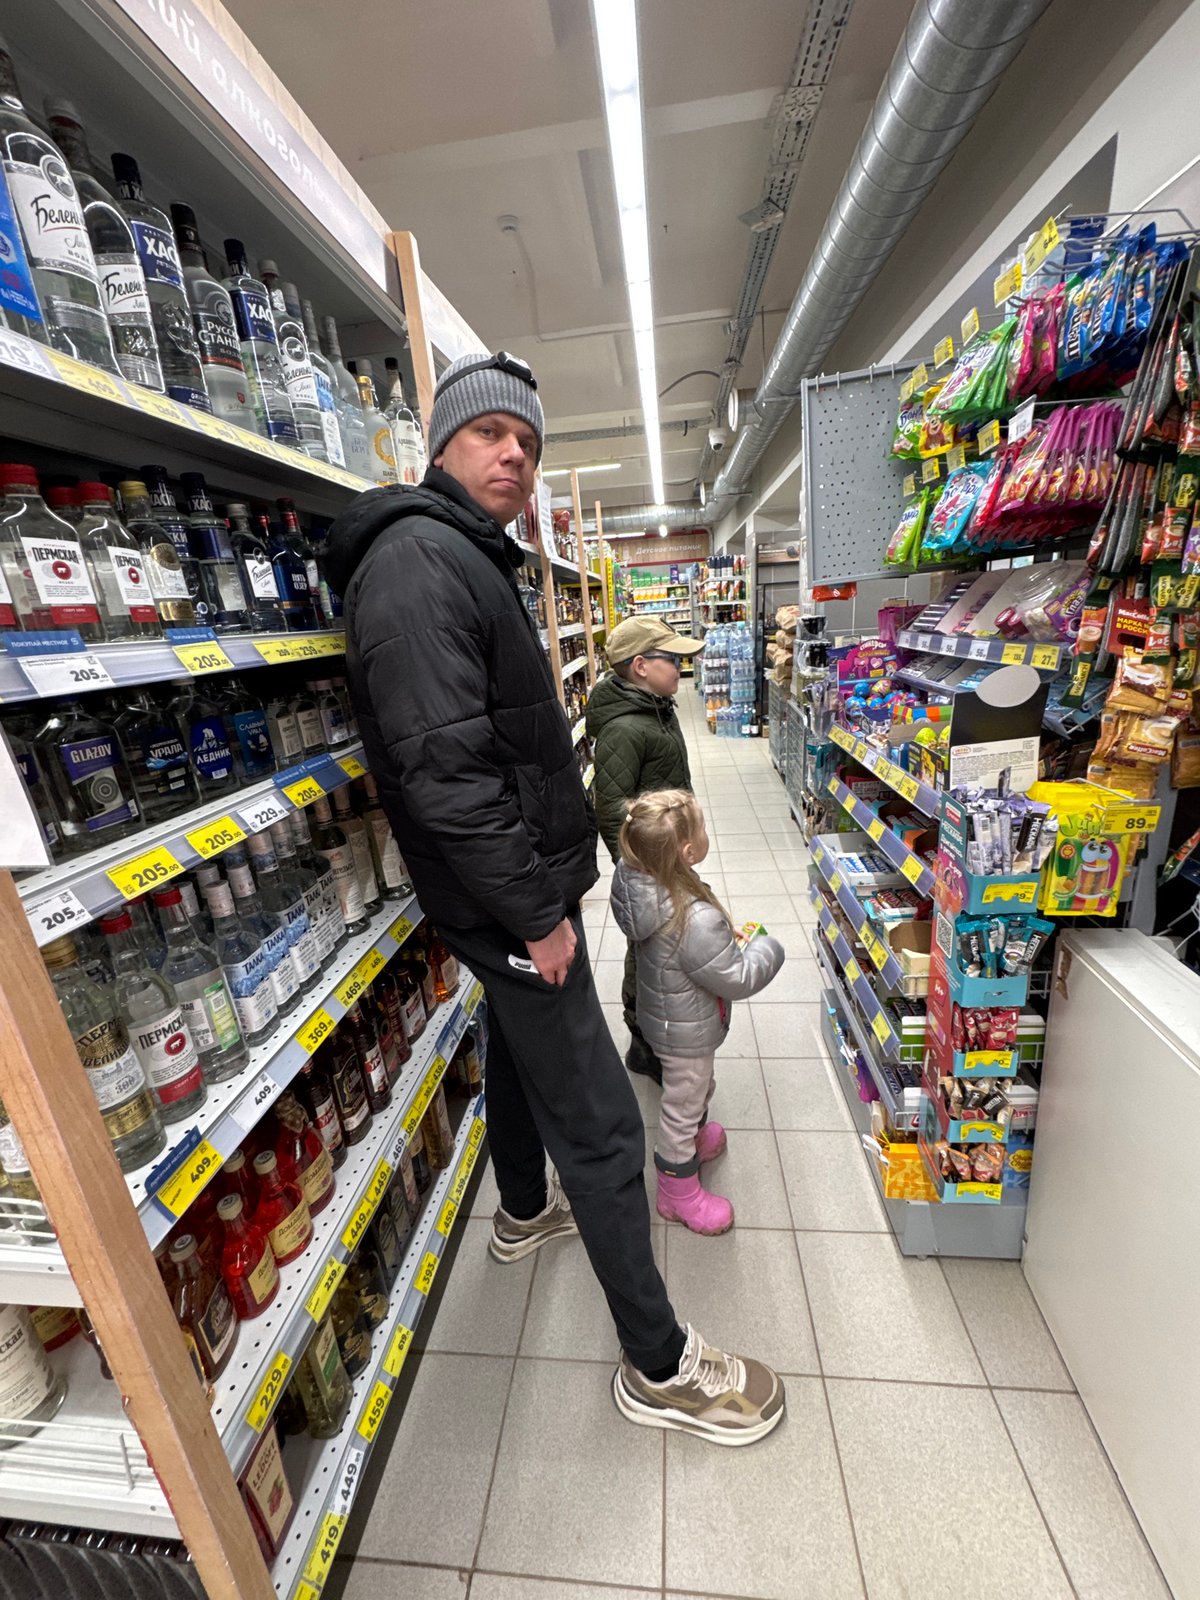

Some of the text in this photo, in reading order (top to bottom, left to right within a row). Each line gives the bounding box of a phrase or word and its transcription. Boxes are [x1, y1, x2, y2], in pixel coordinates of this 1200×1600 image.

[32, 547, 79, 564] ПЕРМСКАЯ
[636, 542, 702, 555] Детское питание
[70, 742, 112, 764] GLAZOV
[150, 743, 183, 759] УРАЛА
[196, 747, 231, 765] ЛЕДНИК
[0, 1327, 25, 1353] ская
